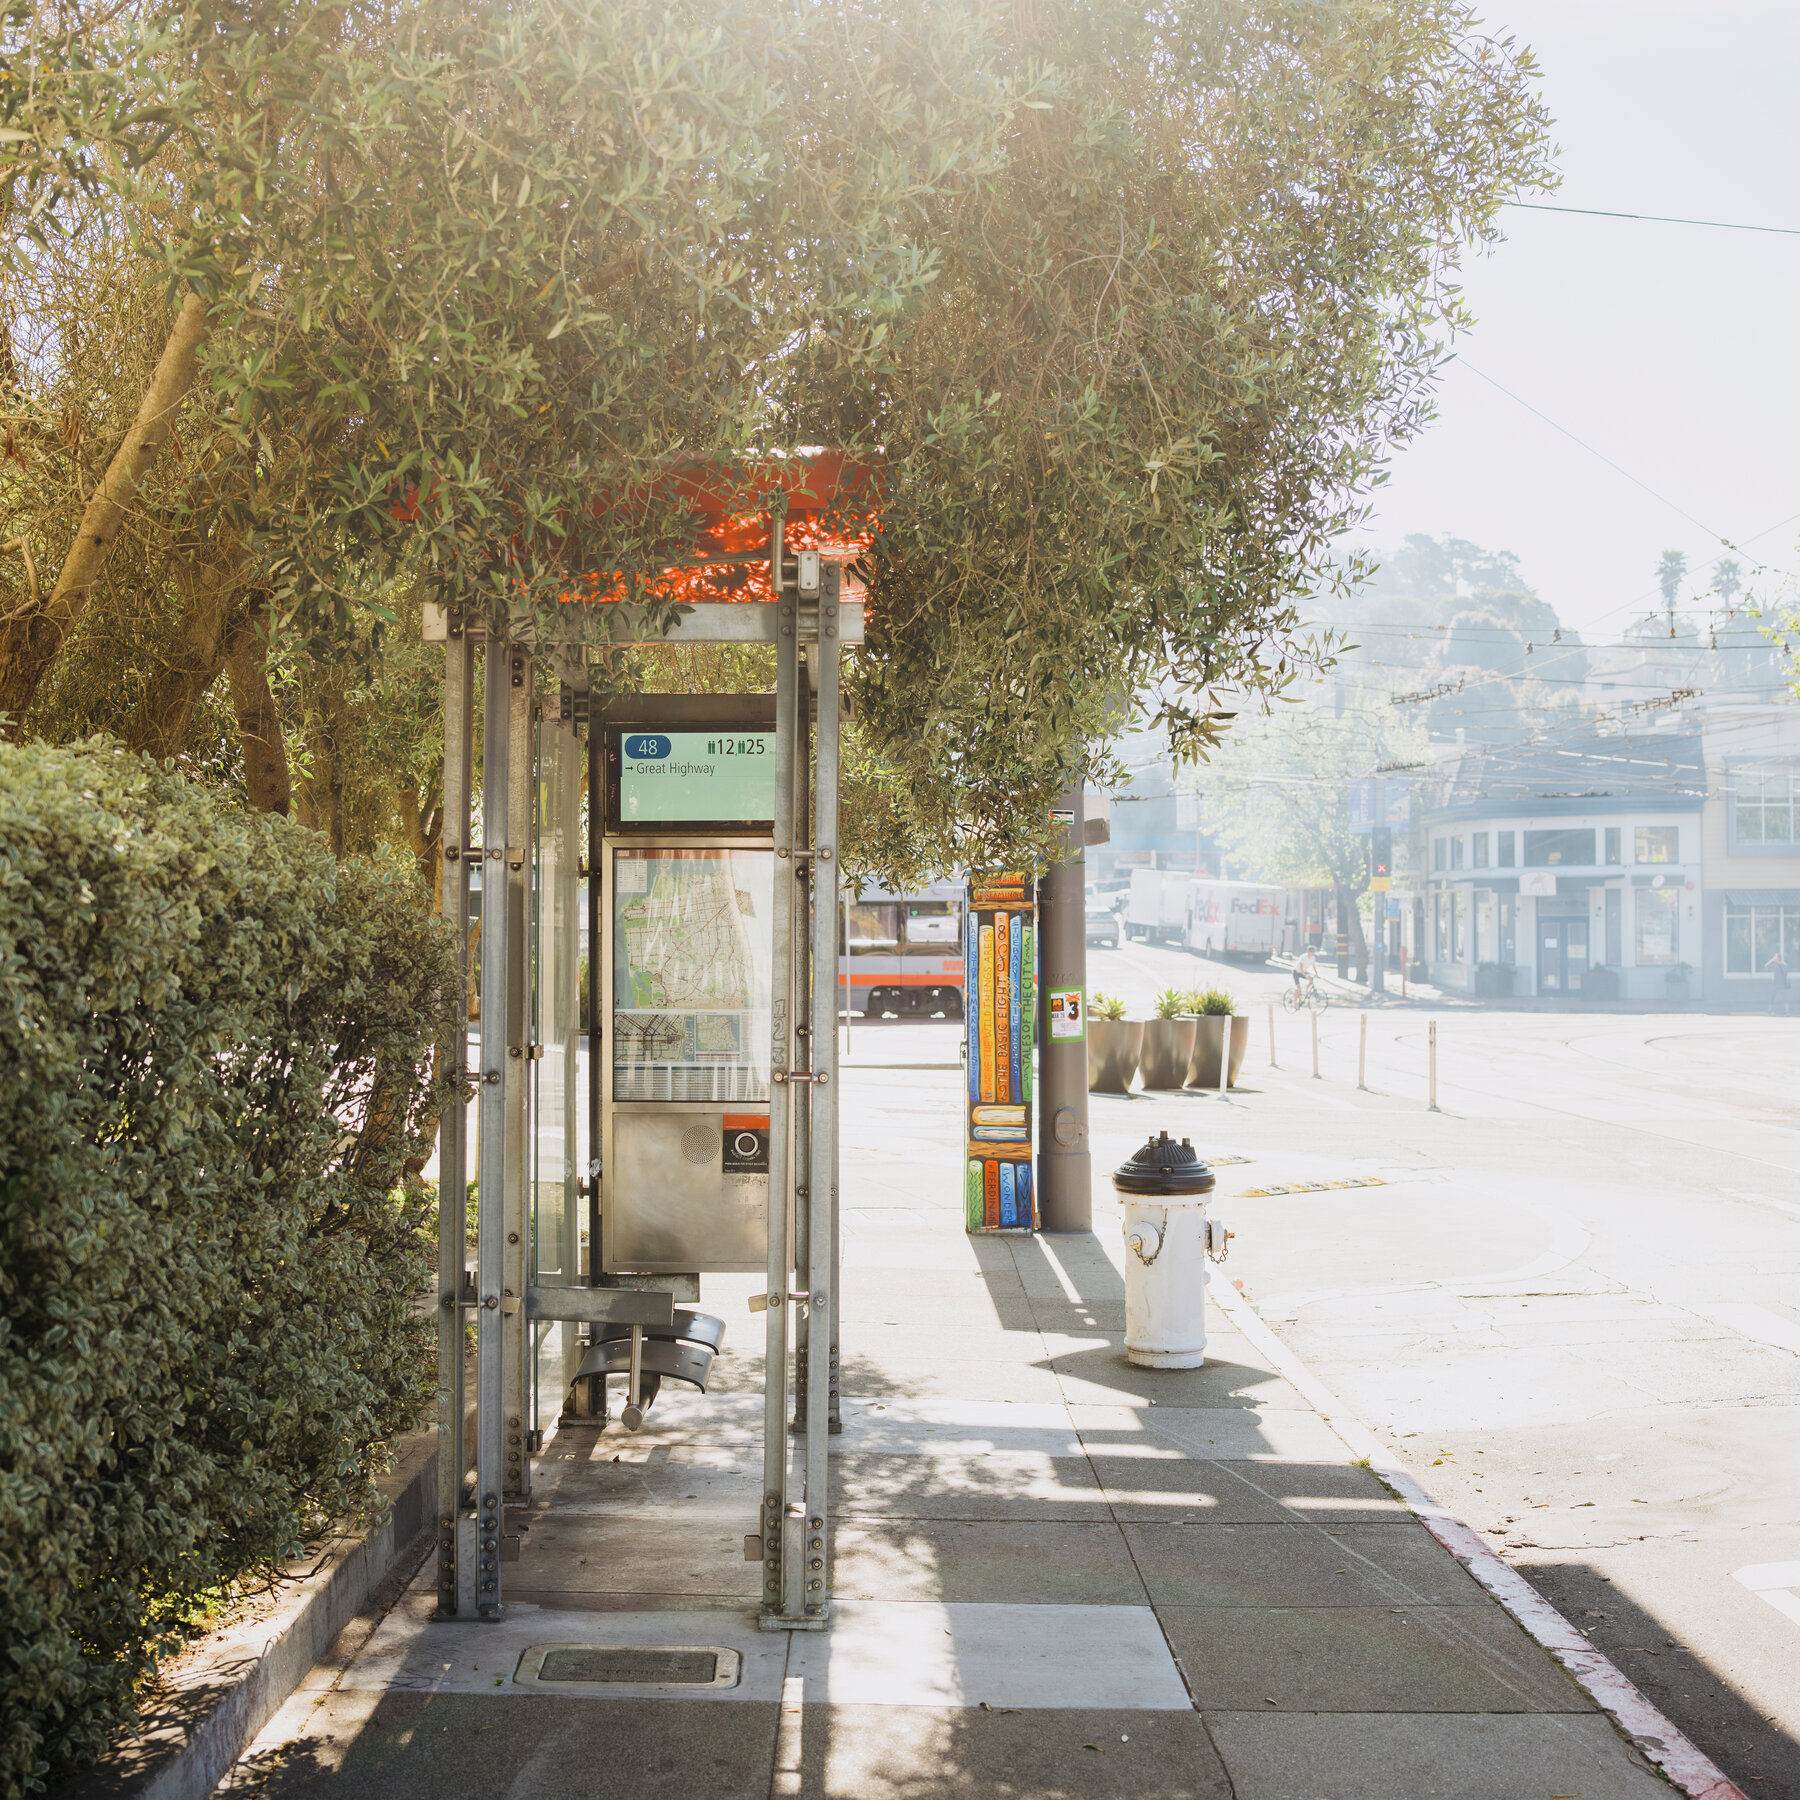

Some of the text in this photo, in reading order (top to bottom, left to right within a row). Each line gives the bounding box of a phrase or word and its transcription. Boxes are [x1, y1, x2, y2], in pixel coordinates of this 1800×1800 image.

[638, 739, 658, 755] 48
[746, 739, 765, 755] 25
[636, 762, 715, 776] Great Highway
[1195, 888, 1220, 922] FedEx
[1231, 898, 1280, 916] FedEx
[970, 983, 977, 995] ON
[997, 975, 1008, 1018] EIGHT
[970, 998, 978, 1054] MARKET
[983, 942, 994, 1092] WHERE THE WILD THINGS ARE
[1022, 959, 1032, 1066] TALES OF THE CITY
[997, 1023, 1008, 1057] BASIC
[997, 1063, 1008, 1085] THE
